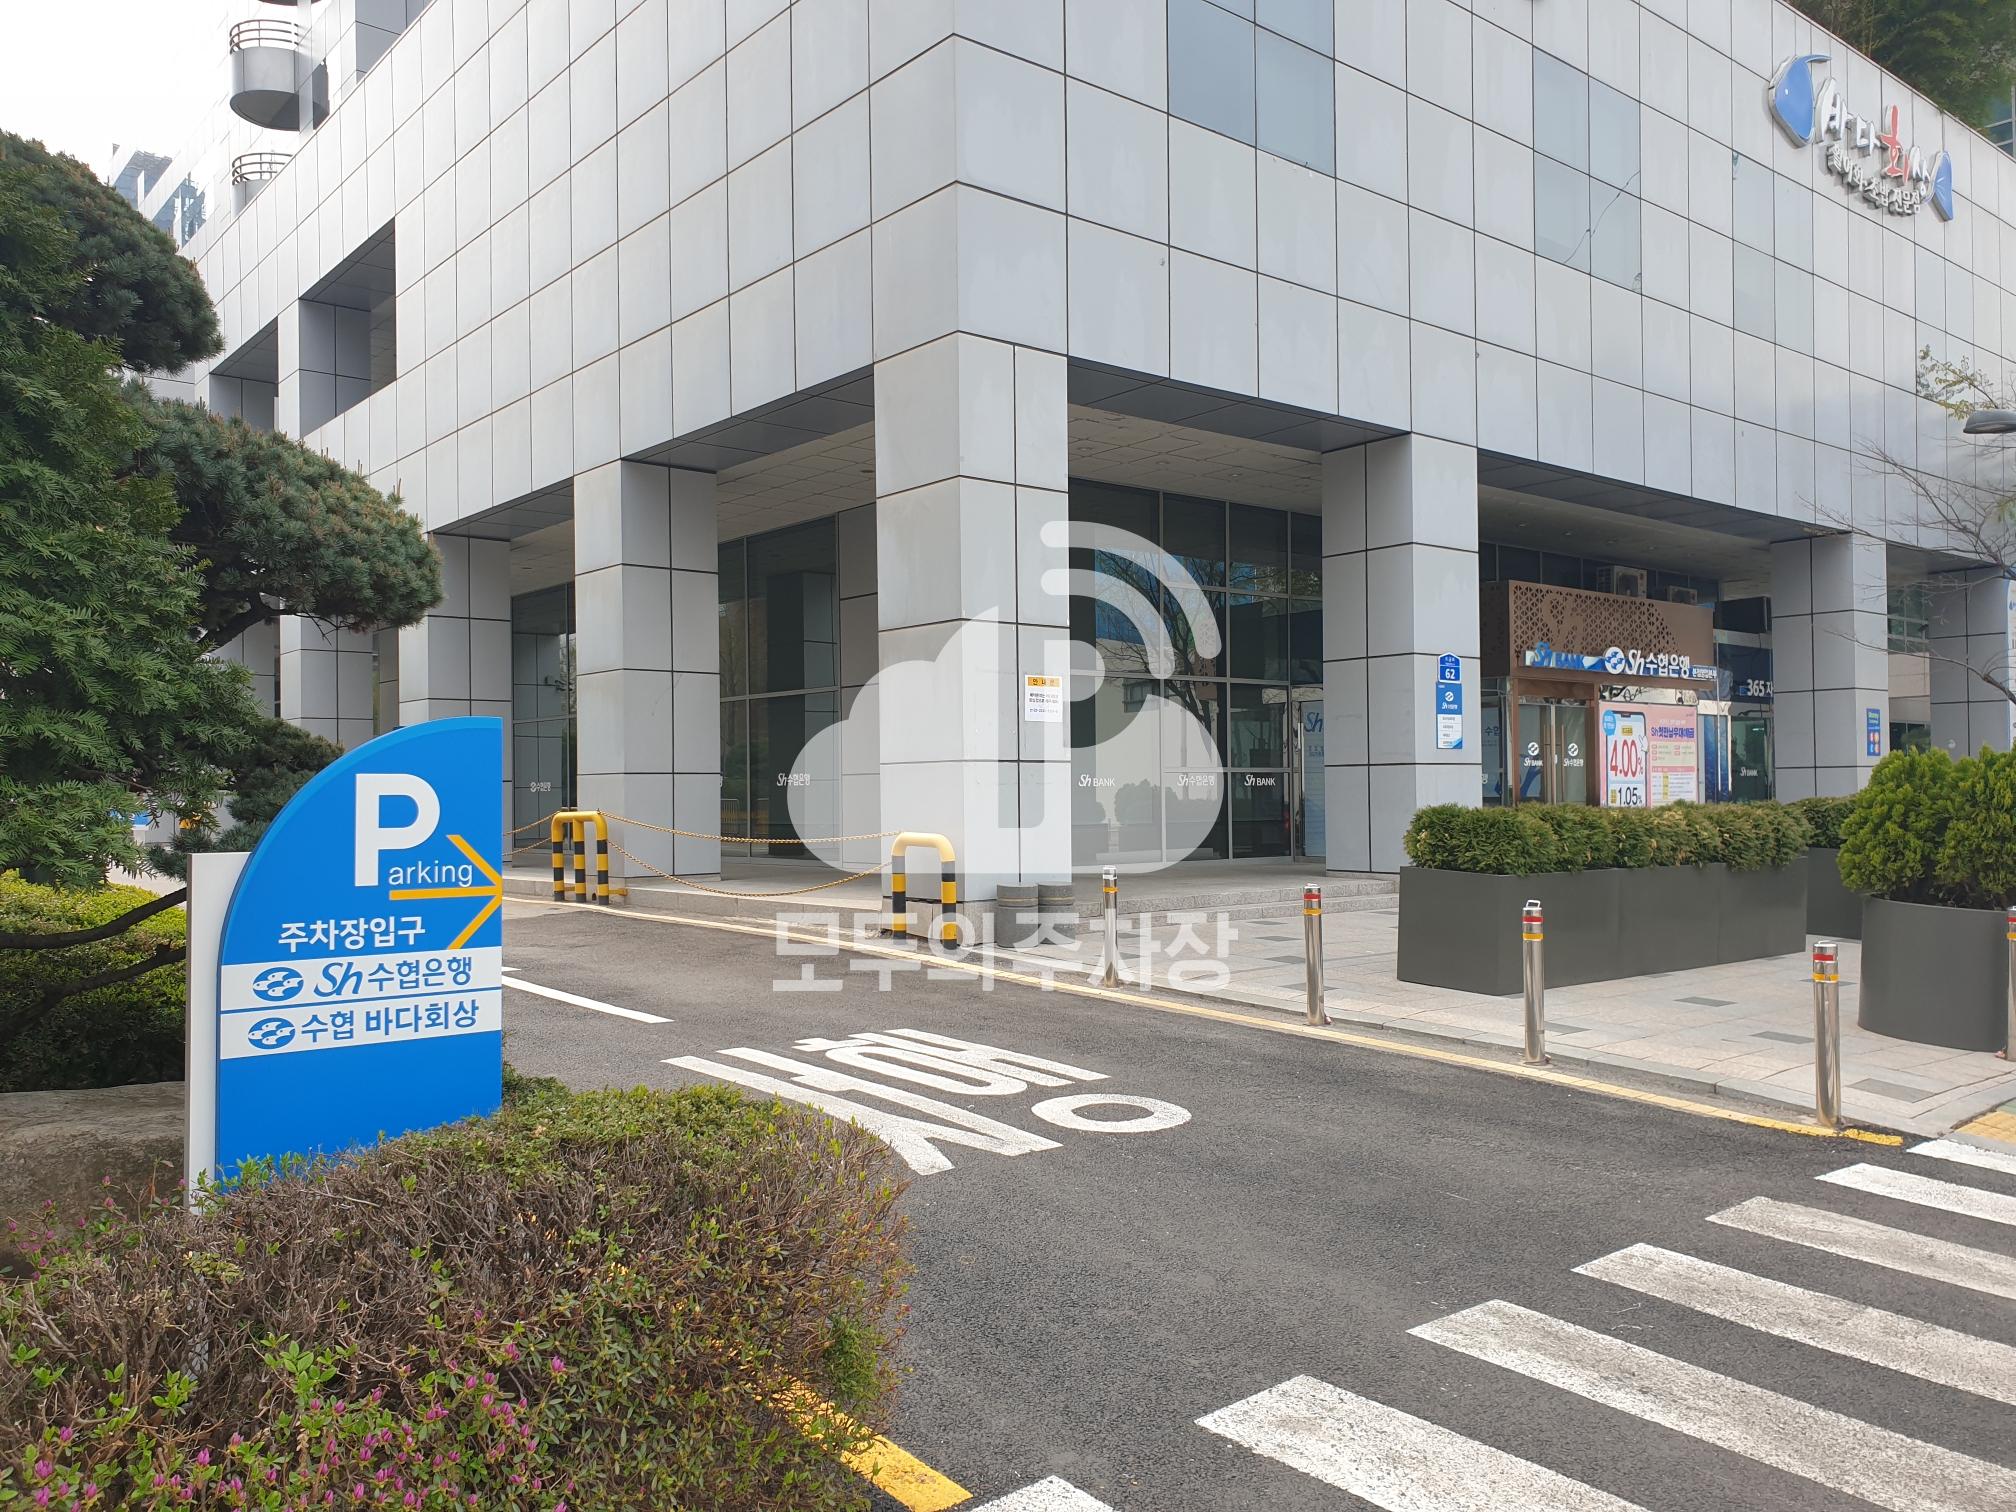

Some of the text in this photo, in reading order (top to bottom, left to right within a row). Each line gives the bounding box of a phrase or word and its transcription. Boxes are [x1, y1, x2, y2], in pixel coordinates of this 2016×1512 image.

[1445, 668, 1455, 680] 62
[1747, 679, 1764, 696] 365
[1078, 774, 1115, 787] Sh BANK
[1244, 774, 1276, 786] Sh BANK
[278, 916, 426, 953] 주차장입구
[301, 999, 480, 1044] 수협 바다회상
